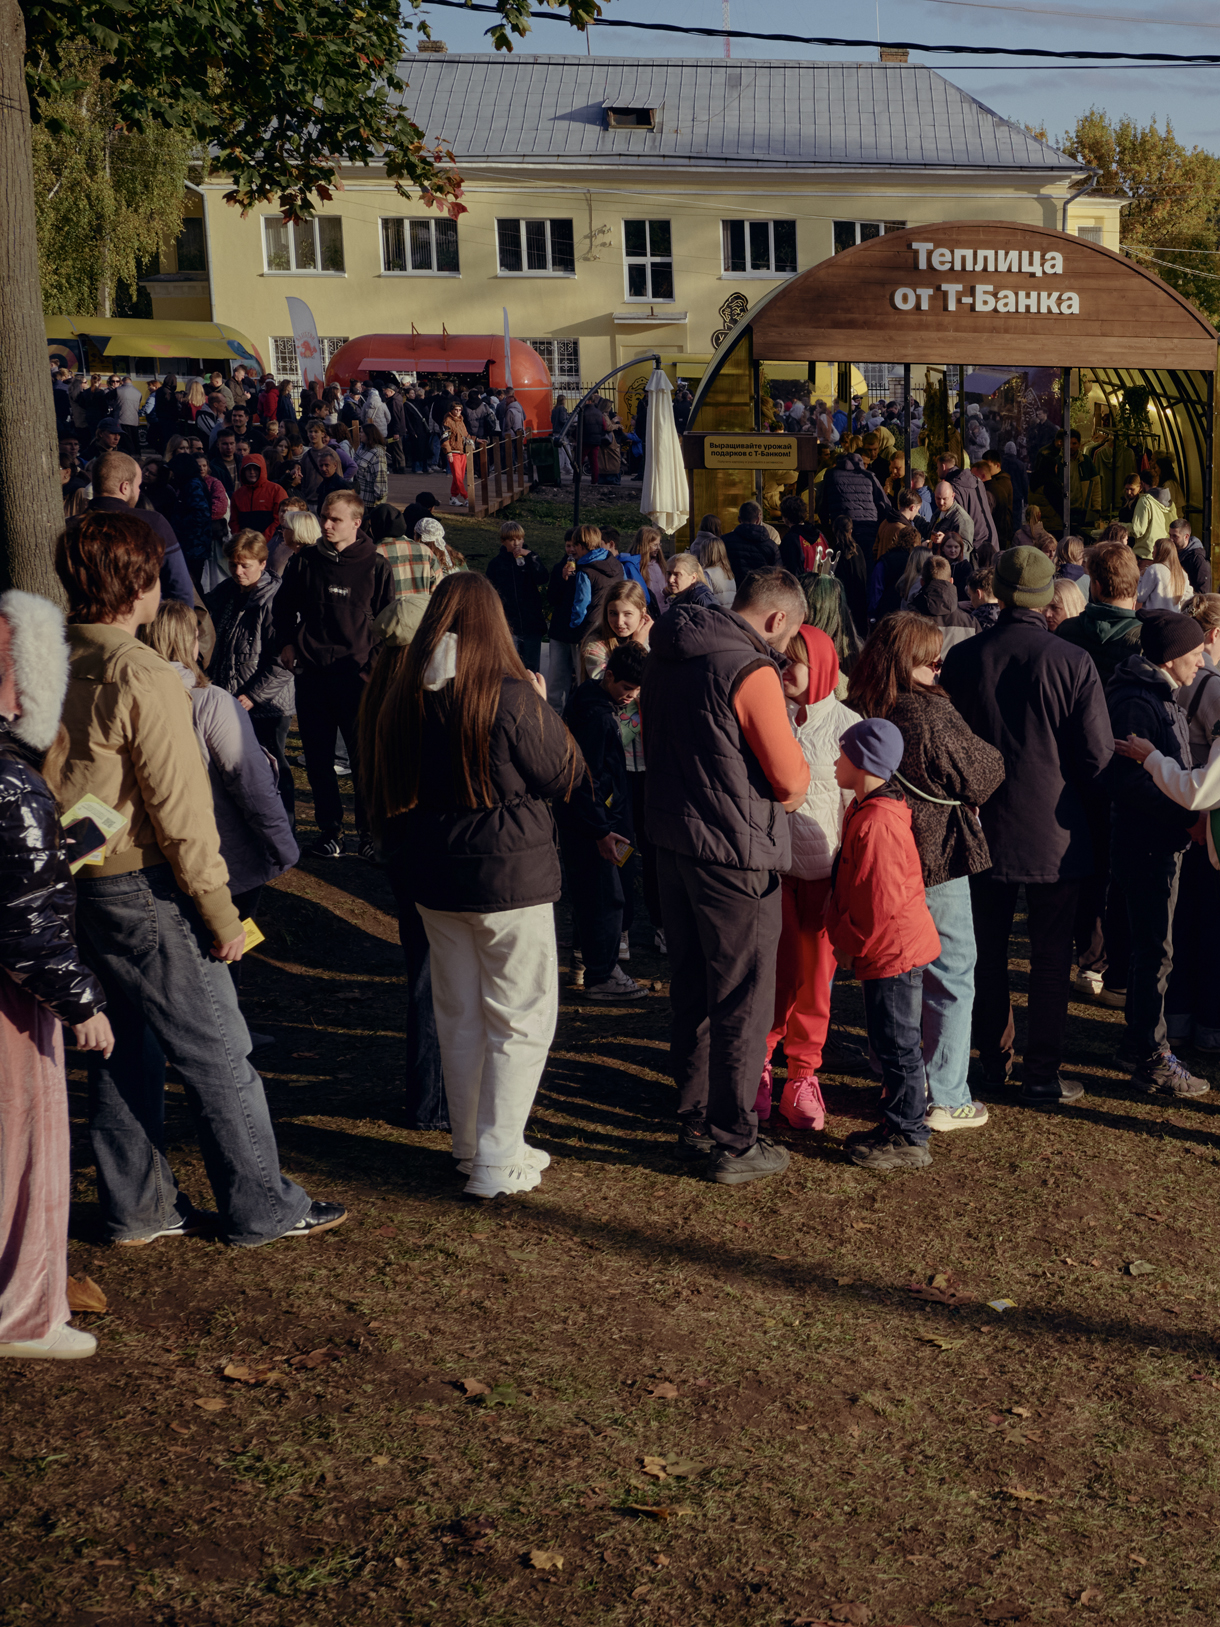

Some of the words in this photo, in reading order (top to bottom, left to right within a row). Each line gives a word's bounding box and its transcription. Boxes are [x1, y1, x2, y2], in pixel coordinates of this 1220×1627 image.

[912, 242, 1063, 277] Теплица
[894, 287, 934, 311] от
[941, 283, 1080, 314] Т-Банка
[710, 442, 762, 450] Выращивайте
[763, 443, 792, 451] урожай
